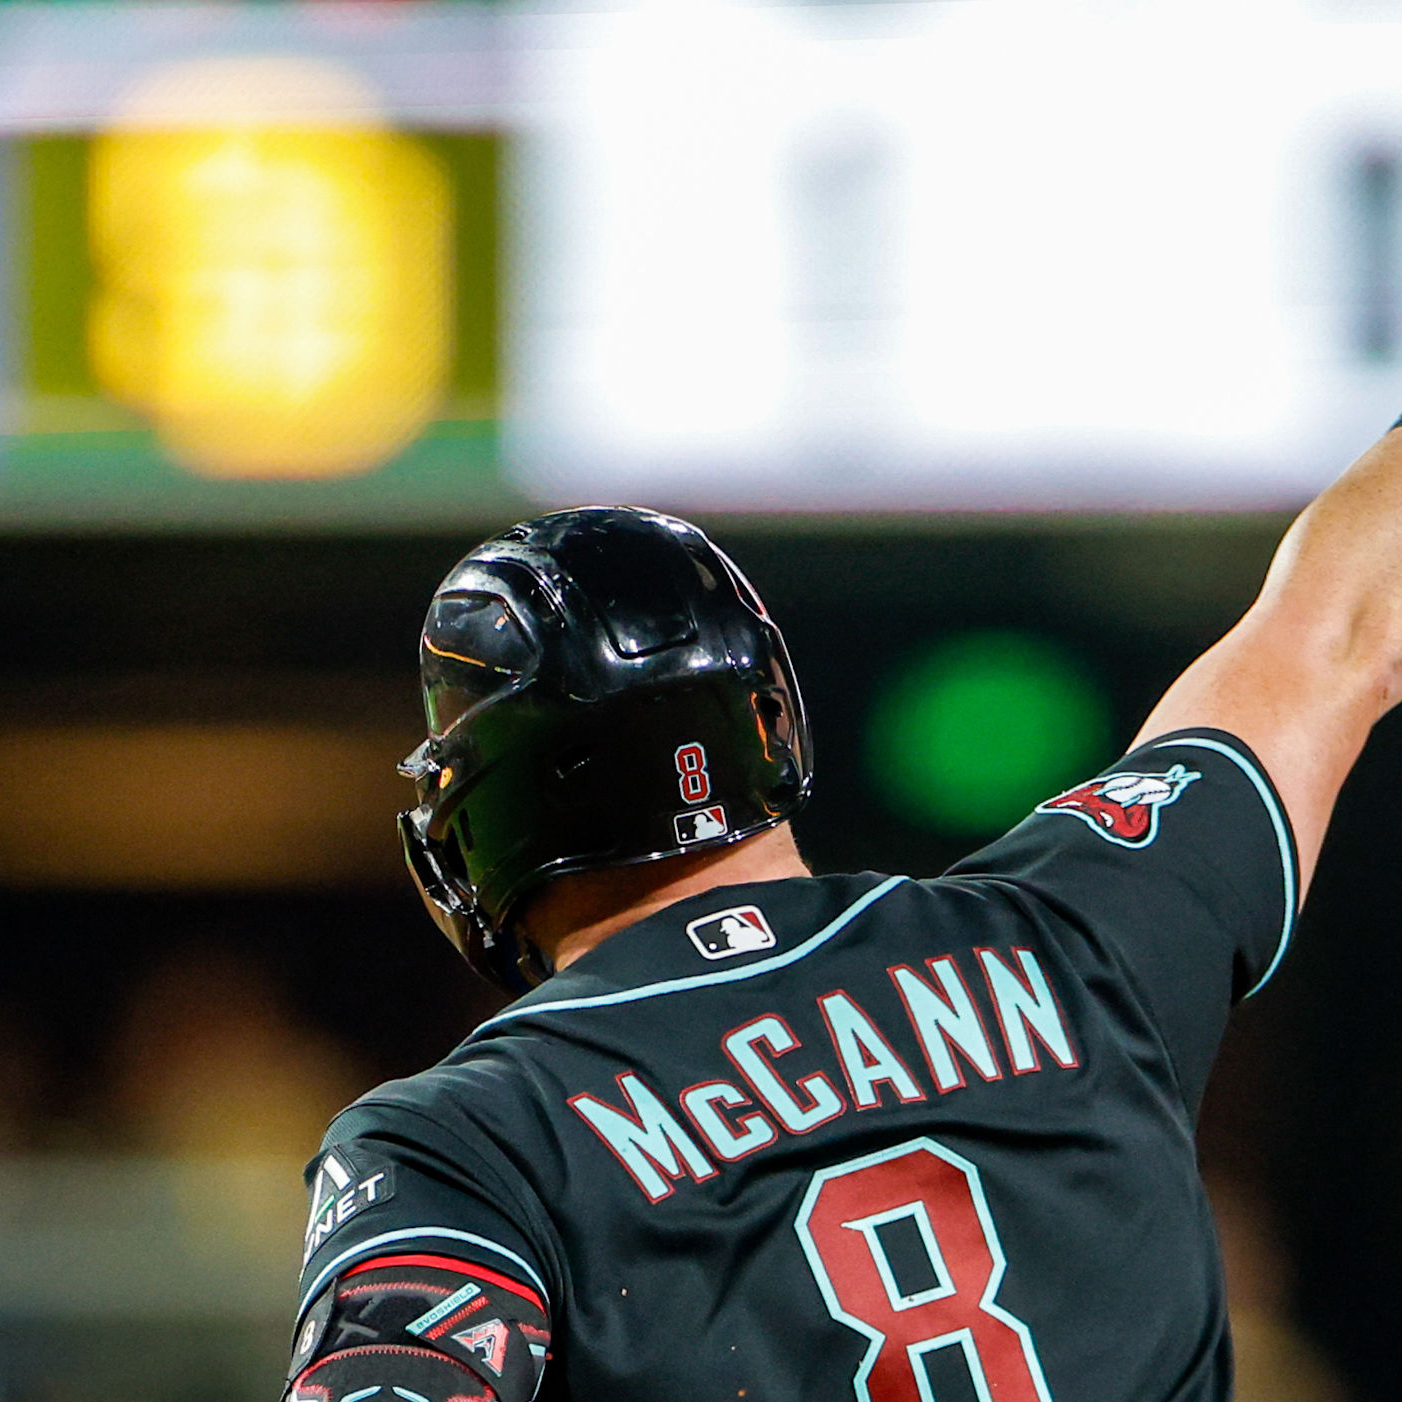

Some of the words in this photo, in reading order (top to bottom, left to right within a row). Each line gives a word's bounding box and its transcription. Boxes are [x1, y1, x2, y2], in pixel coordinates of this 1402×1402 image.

[674, 741, 711, 804] 8
[567, 946, 1079, 1204] McCANN
[299, 1319, 316, 1355] 8
